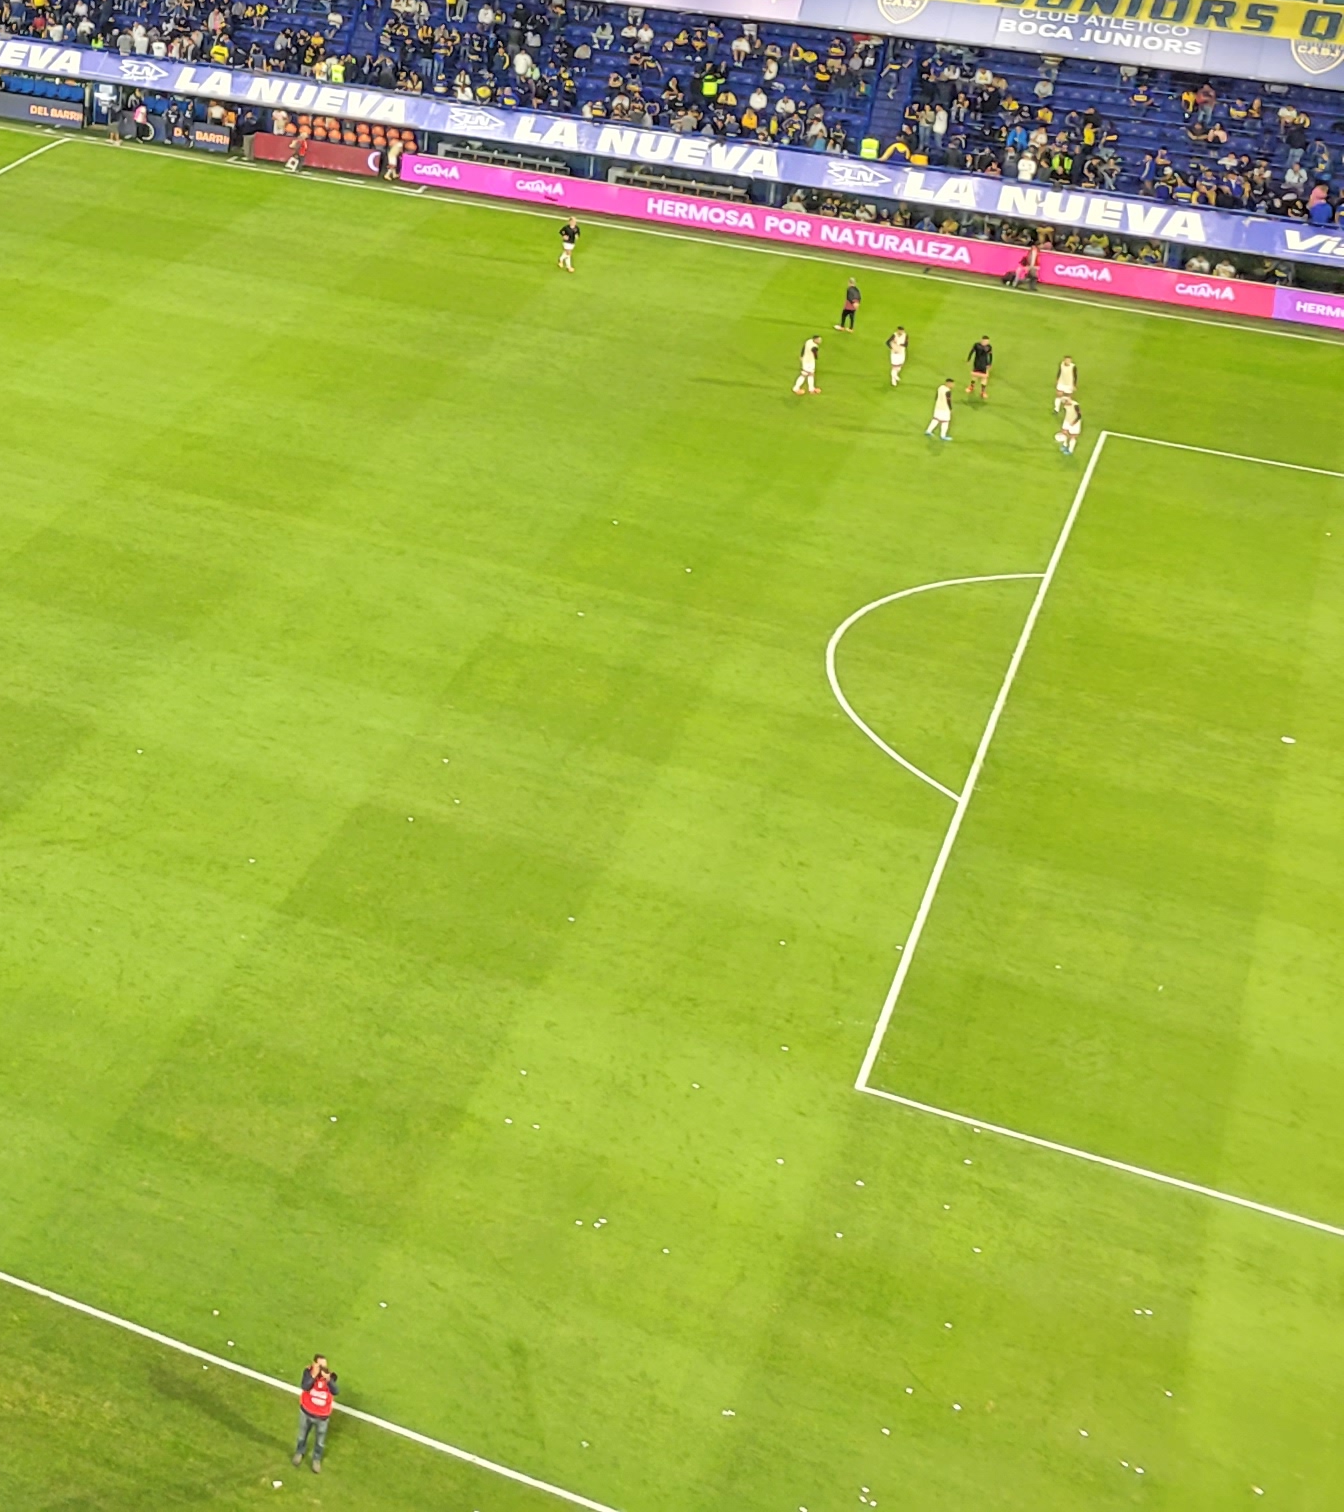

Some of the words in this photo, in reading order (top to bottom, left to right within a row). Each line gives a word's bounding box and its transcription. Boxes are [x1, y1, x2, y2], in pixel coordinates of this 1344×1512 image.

[1018, 7, 1080, 24] CLUB
[998, 19, 1074, 41] BOCA
[1080, 30, 1202, 55] JUNIORS
[30, 104, 48, 117] DEL
[174, 66, 232, 96] LA
[247, 77, 406, 124] NUEVA
[513, 116, 579, 149] LA
[597, 127, 779, 177] NUEVA
[903, 171, 978, 208] LA
[997, 185, 1207, 242] NUEVA
[413, 163, 460, 181] CATAMA
[516, 179, 565, 197] CATAMA
[647, 197, 755, 230] HERMOSA
[764, 214, 811, 238] POR
[820, 225, 971, 265] NATURALEZA
[1055, 263, 1112, 283] CATAMA
[1175, 282, 1235, 302] CATAMA
